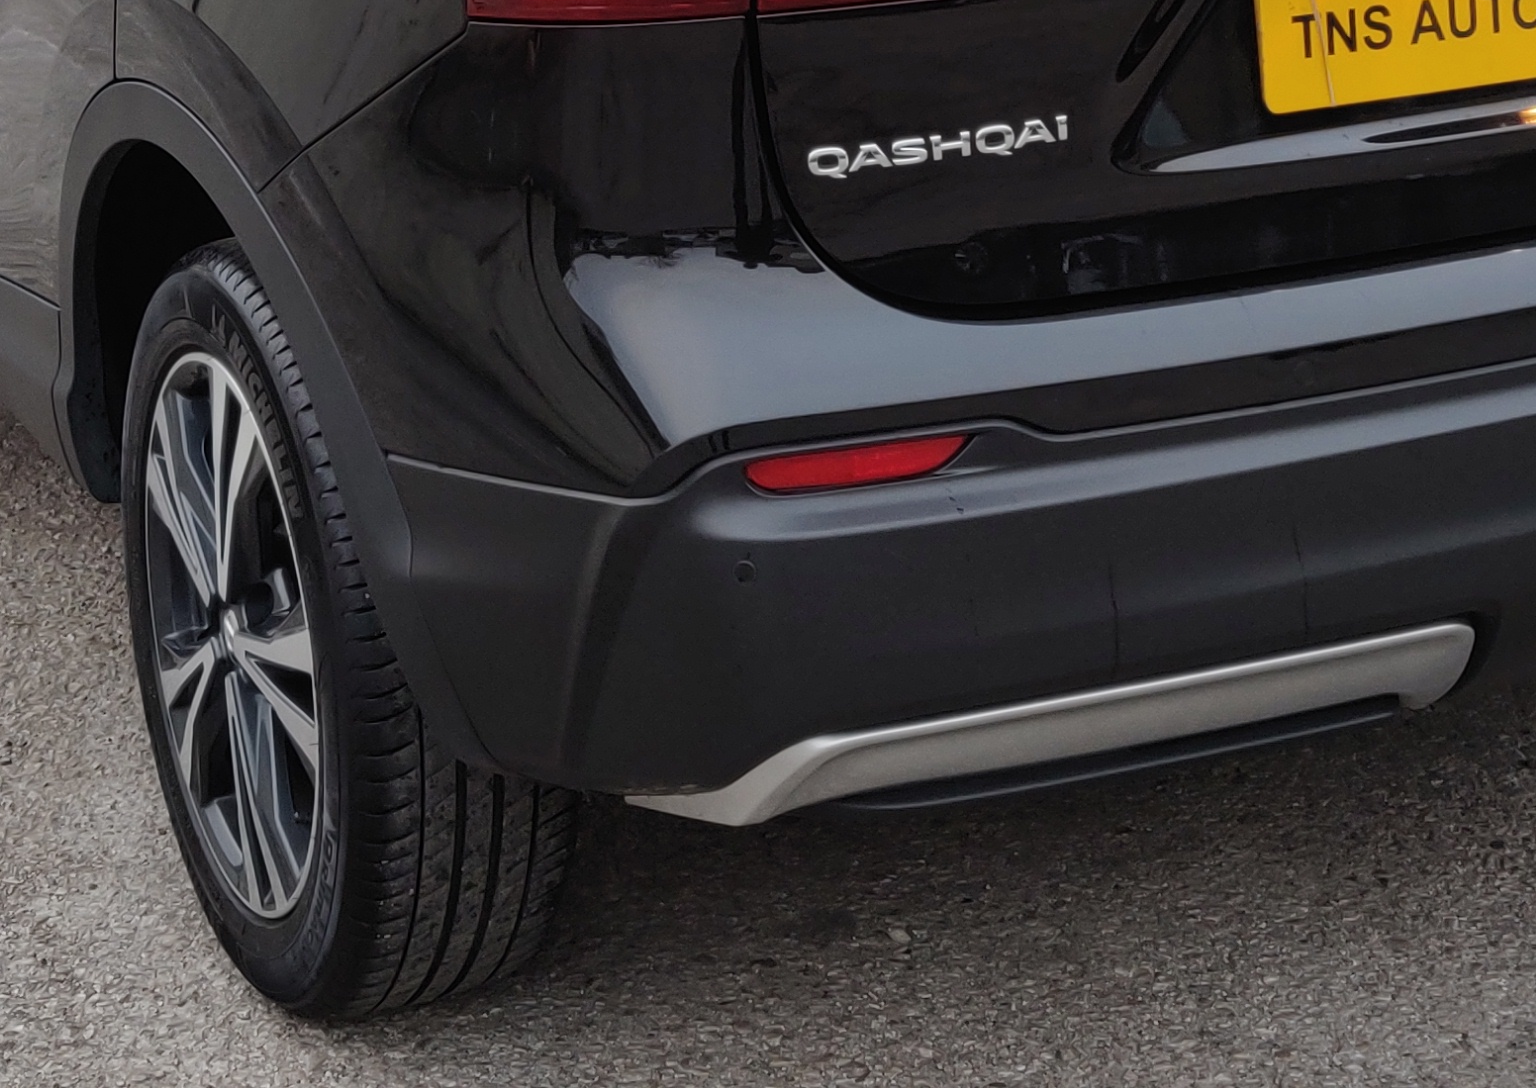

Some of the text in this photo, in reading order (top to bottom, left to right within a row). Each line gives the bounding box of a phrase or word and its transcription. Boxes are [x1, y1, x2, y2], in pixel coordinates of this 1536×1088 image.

[1292, 4, 1393, 60] TNS
[807, 114, 1068, 179] QASHQAI
[228, 329, 305, 519] MICHELIN
